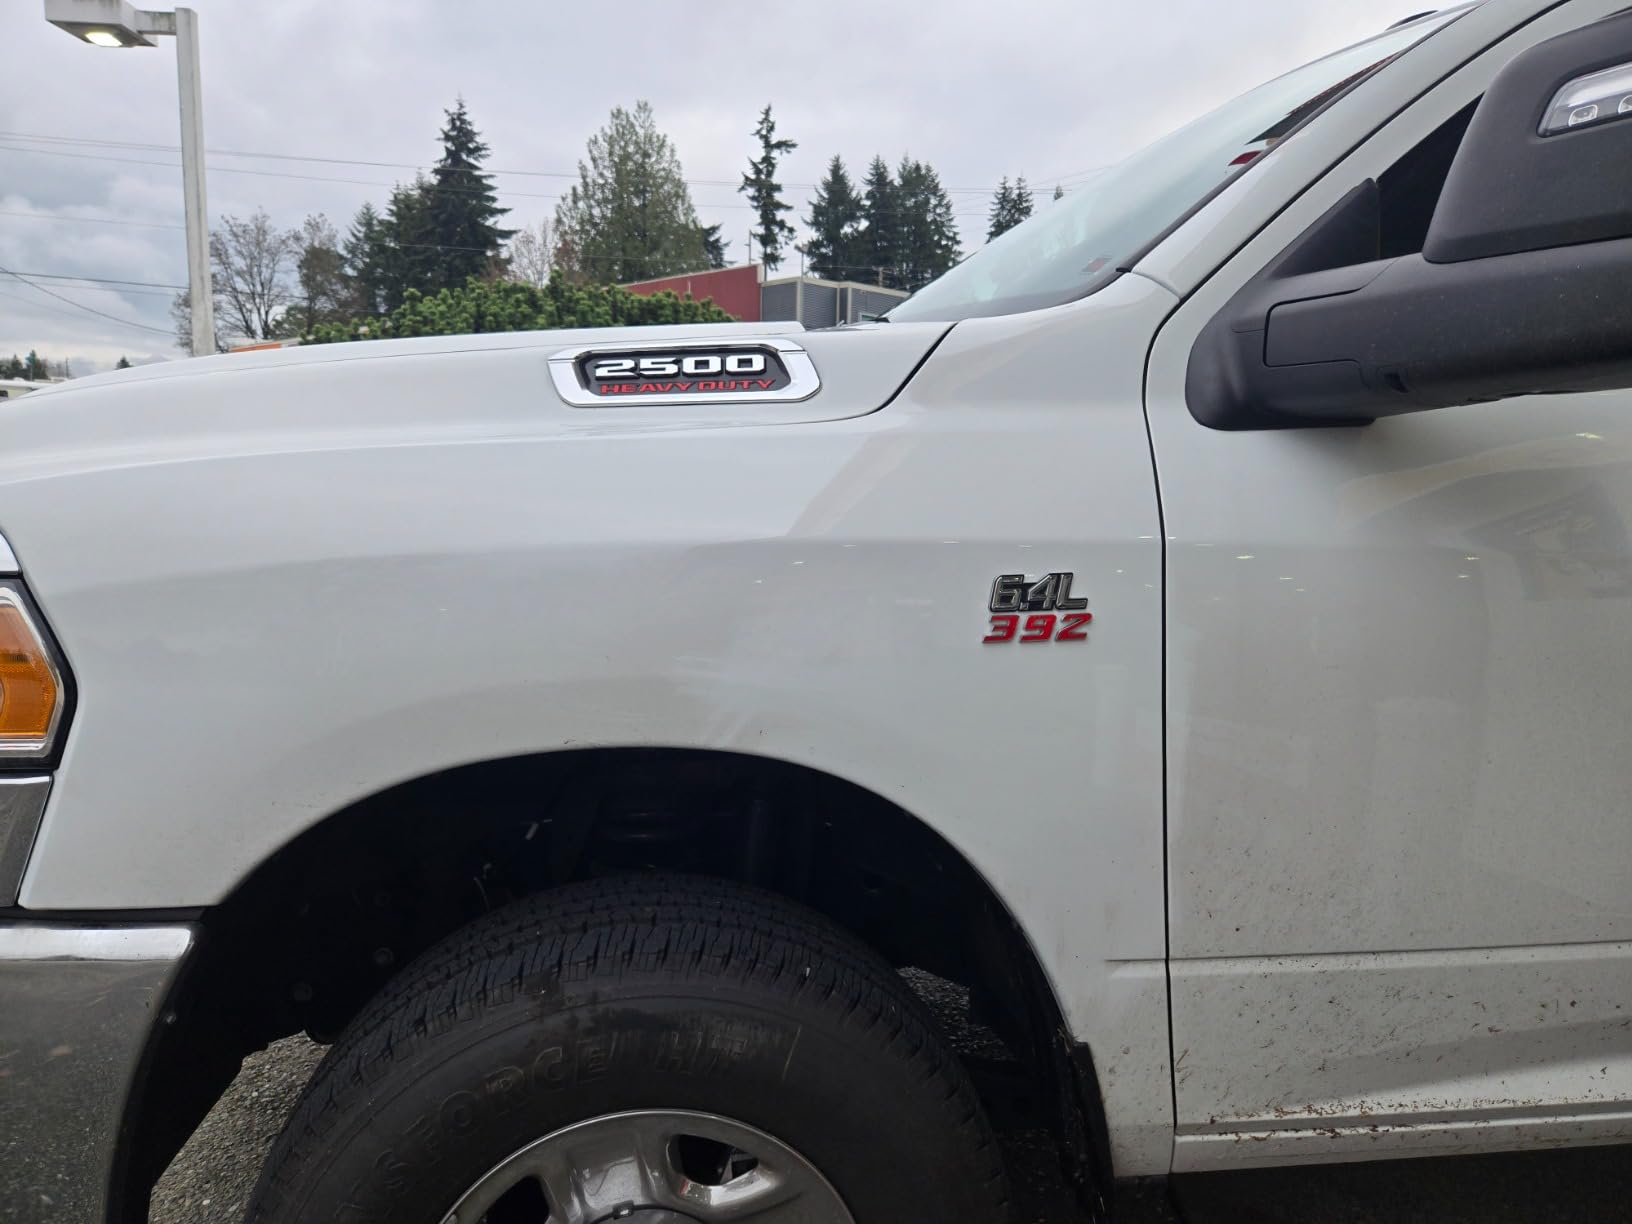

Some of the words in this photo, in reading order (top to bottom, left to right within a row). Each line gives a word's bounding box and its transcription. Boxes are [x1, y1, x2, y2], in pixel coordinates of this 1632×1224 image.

[595, 354, 766, 377] 2500
[600, 381, 693, 395] HEAVY
[698, 378, 776, 392] DUTY
[989, 572, 1088, 612] 6.4L
[982, 613, 1092, 643] 392
